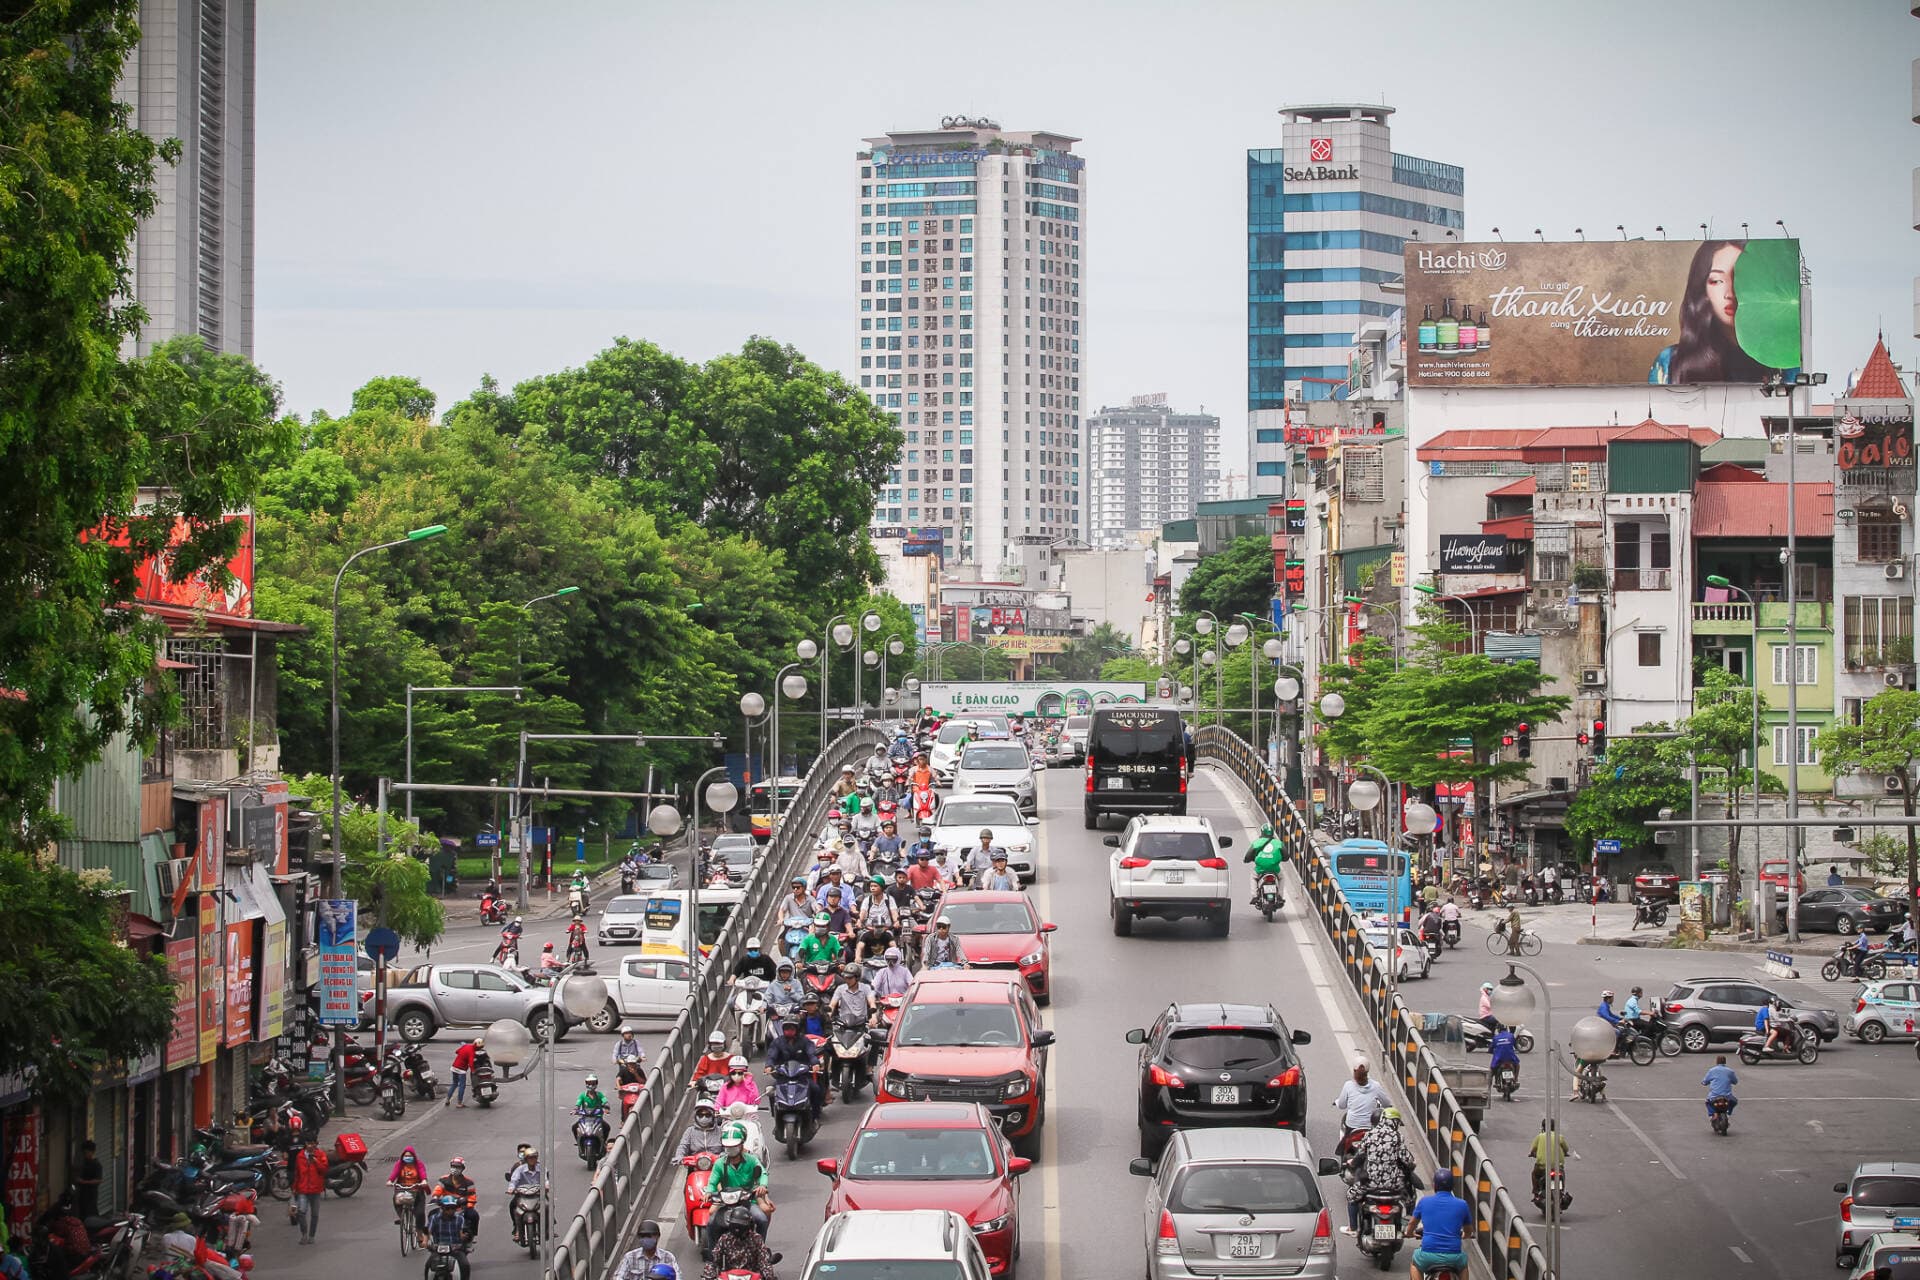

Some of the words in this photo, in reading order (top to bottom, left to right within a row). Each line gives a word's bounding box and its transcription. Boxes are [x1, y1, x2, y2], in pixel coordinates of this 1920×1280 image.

[891, 151, 938, 165] OCEAN
[941, 149, 988, 163] GROUP
[1284, 154, 1359, 181] SeABank
[1418, 252, 1476, 269] Hachi
[1489, 286, 1585, 317] thanh
[1551, 321, 1569, 329] cùng
[1572, 316, 1623, 337] thiên
[1624, 318, 1672, 337] nhiên
[1418, 361, 1490, 369] www.hachivietnam.vn
[1838, 428, 1910, 470] Café
[992, 607, 1024, 625] BI-A
[966, 693, 988, 704] BÀN
[992, 695, 1019, 704] GIAO
[915, 1088, 998, 1096] FORD
[1215, 1094, 1236, 1103] 3739
[1237, 1235, 1253, 1245] 29A
[1232, 1246, 1259, 1256] 28157
